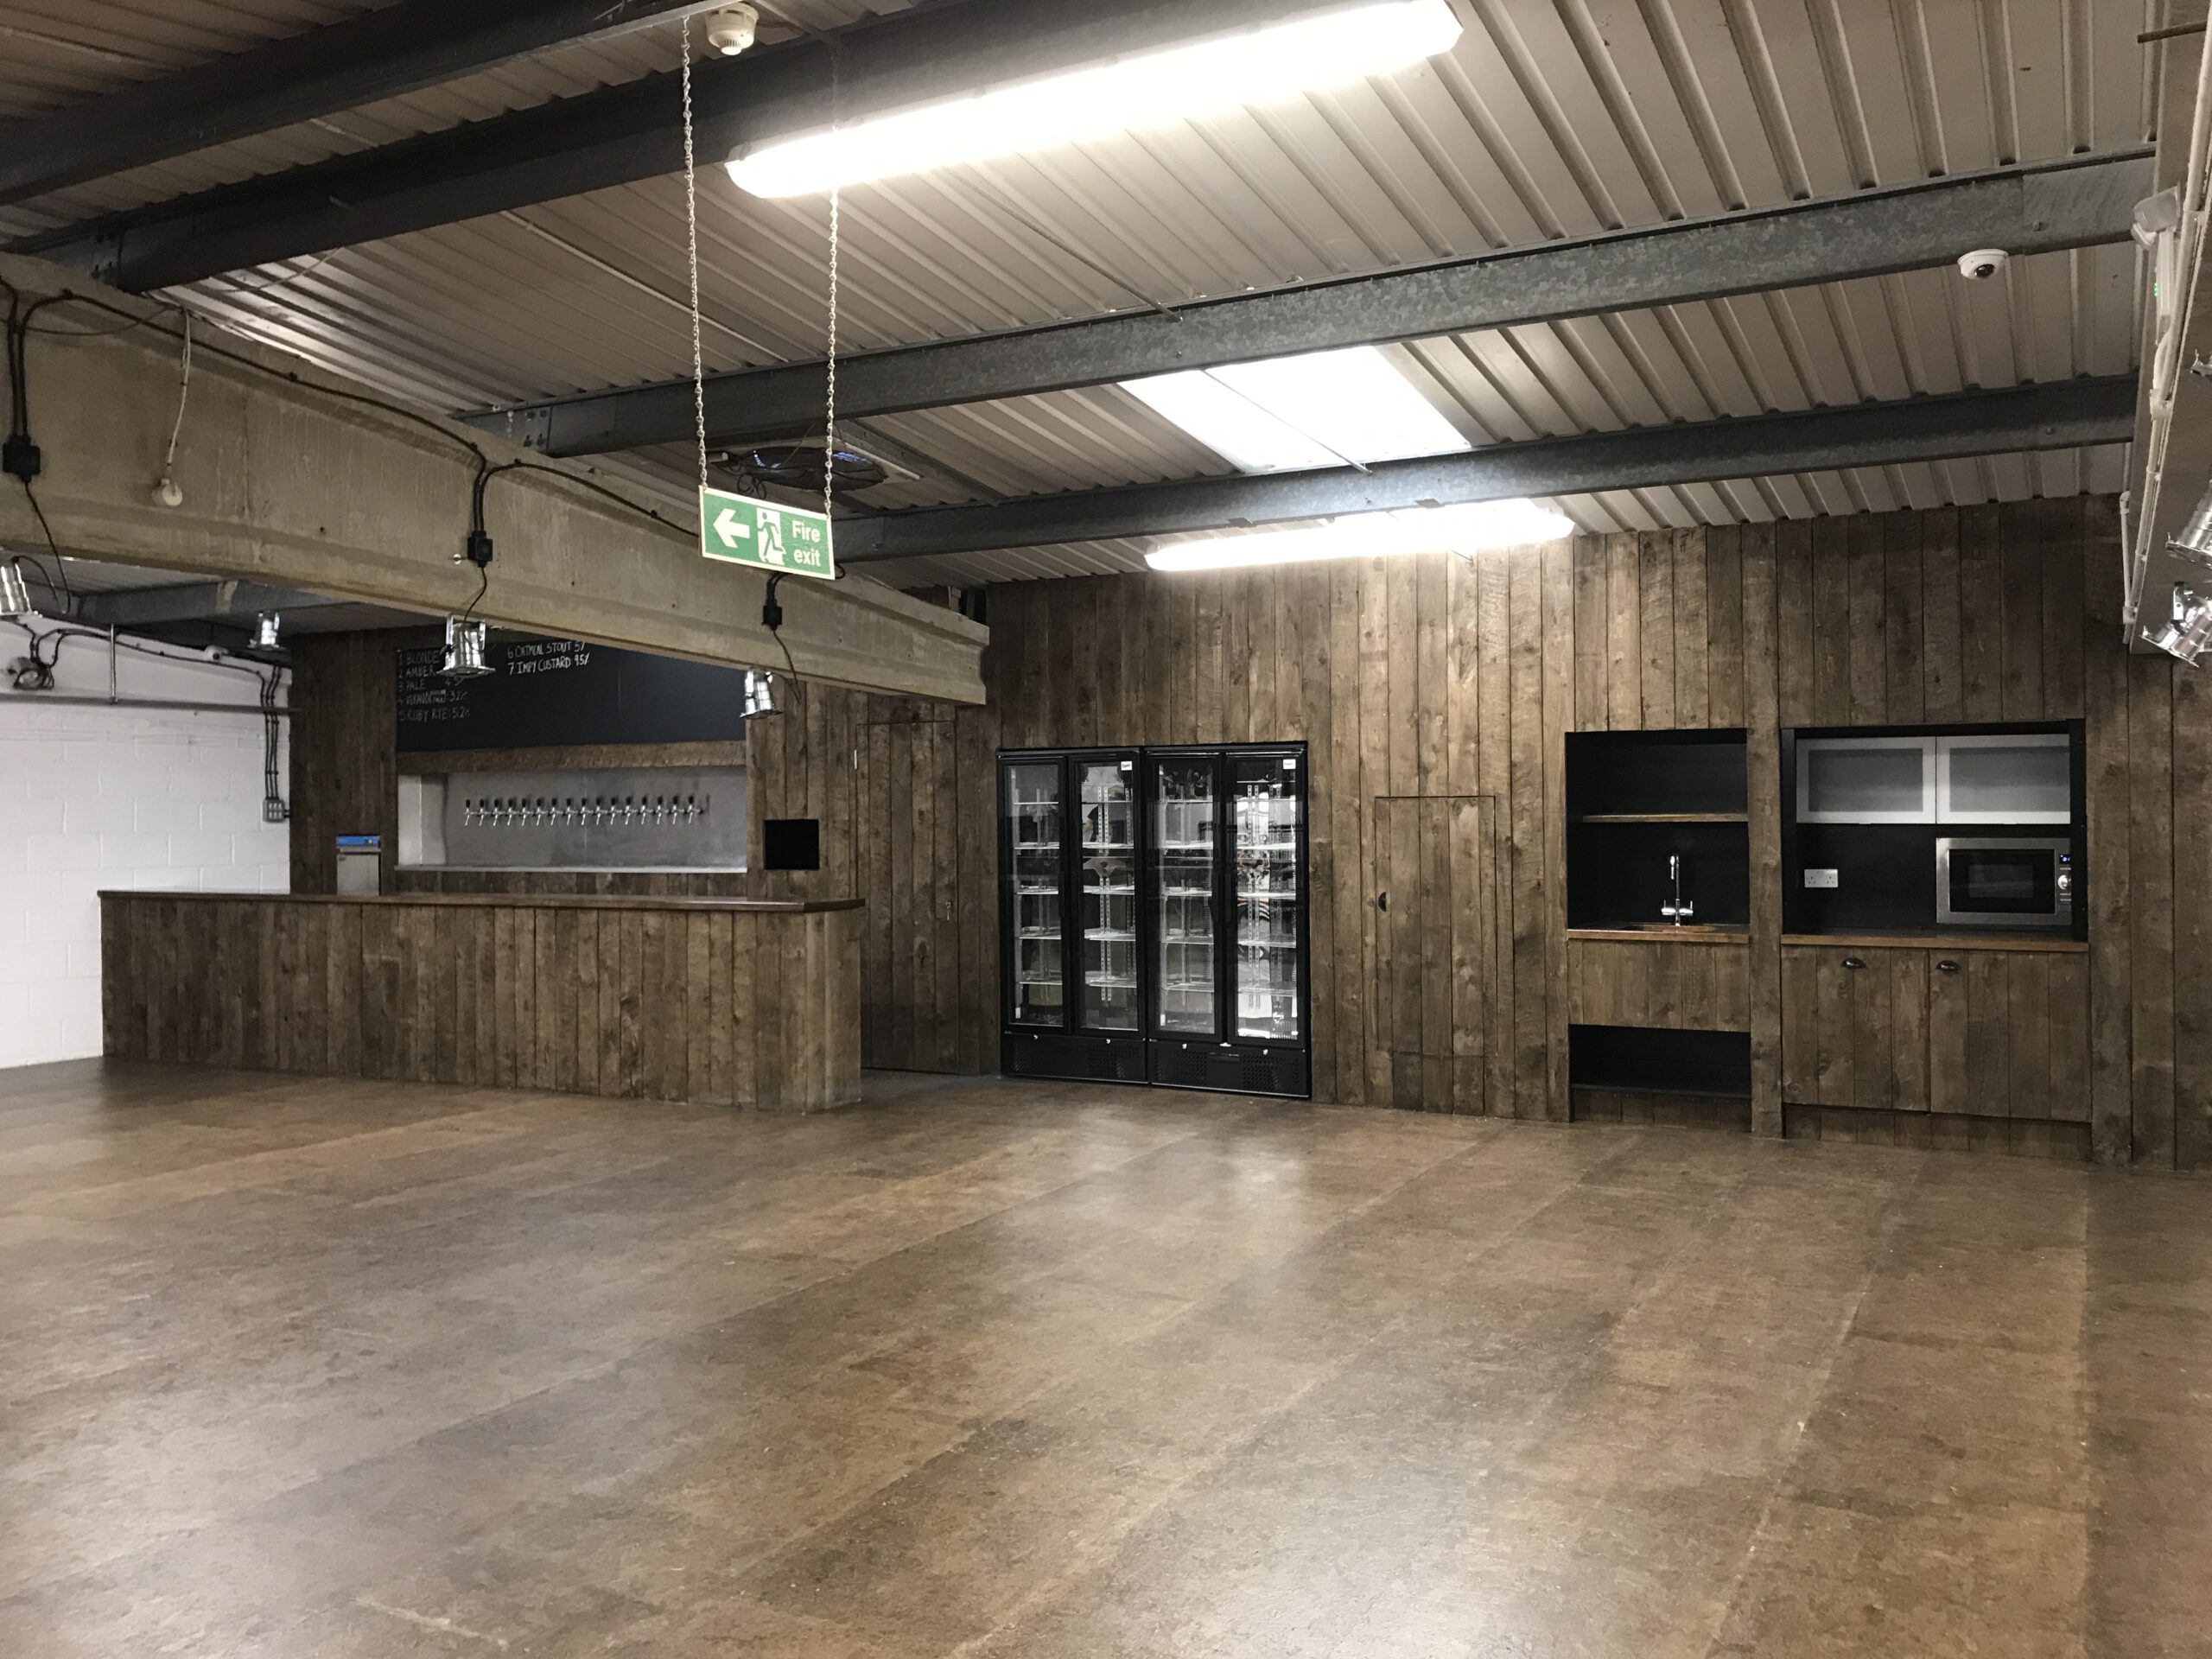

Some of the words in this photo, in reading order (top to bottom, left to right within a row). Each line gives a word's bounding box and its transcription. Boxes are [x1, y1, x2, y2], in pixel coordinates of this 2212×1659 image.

[791, 520, 821, 543] Fire
[793, 547, 821, 567] exit
[546, 641, 571, 654] STOUT
[406, 650, 440, 665] BLONDE
[538, 656, 571, 671] CUSTARD
[405, 664, 436, 677] AMBER
[406, 678, 426, 691] PALE
